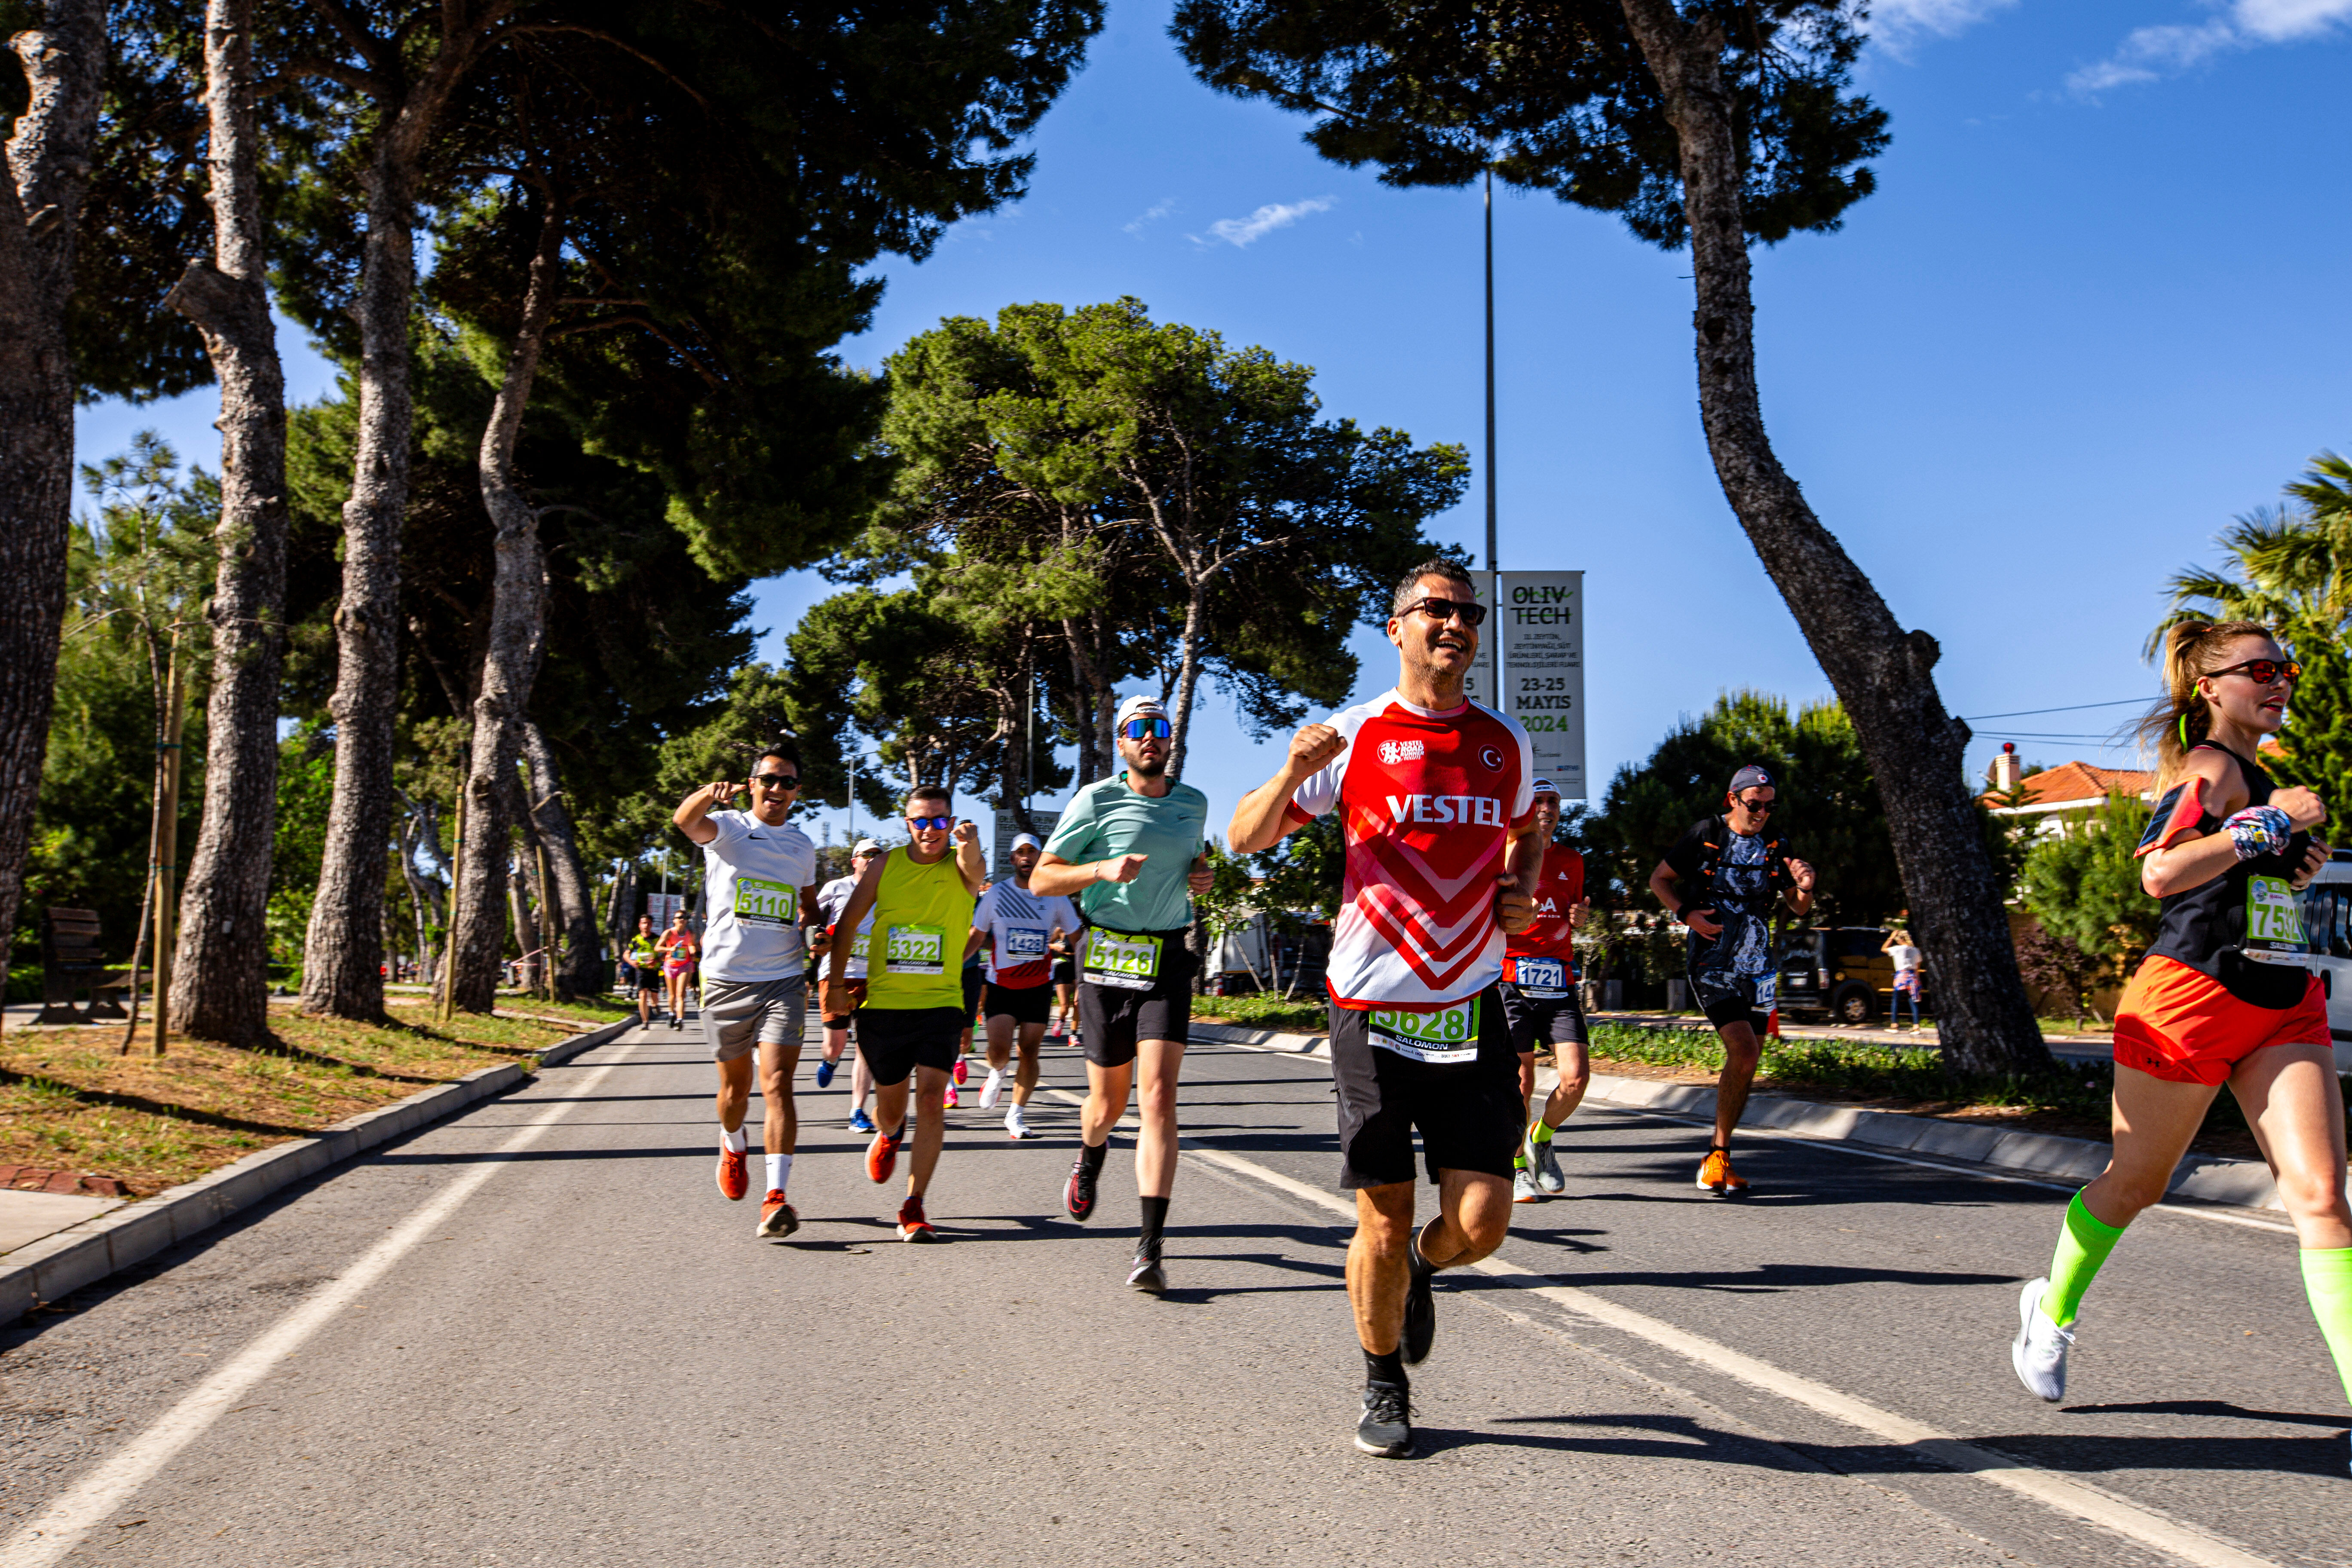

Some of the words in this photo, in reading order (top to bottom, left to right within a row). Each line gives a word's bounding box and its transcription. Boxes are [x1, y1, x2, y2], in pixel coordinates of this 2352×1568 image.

[1512, 586, 1568, 604] OLIV
[1510, 606, 1571, 625] TECH
[1521, 677, 1565, 691] 23-25
[1516, 695, 1571, 709] MAYIS
[1520, 715, 1568, 732] 2024
[1385, 794, 1504, 828] VESTEL
[740, 893, 789, 917] 5110
[889, 940, 937, 959] 5322
[1092, 945, 1151, 972] 5126
[1522, 968, 1559, 986] 1721
[1378, 1010, 1465, 1040] 5628
[1396, 1035, 1449, 1050] SALOMON
